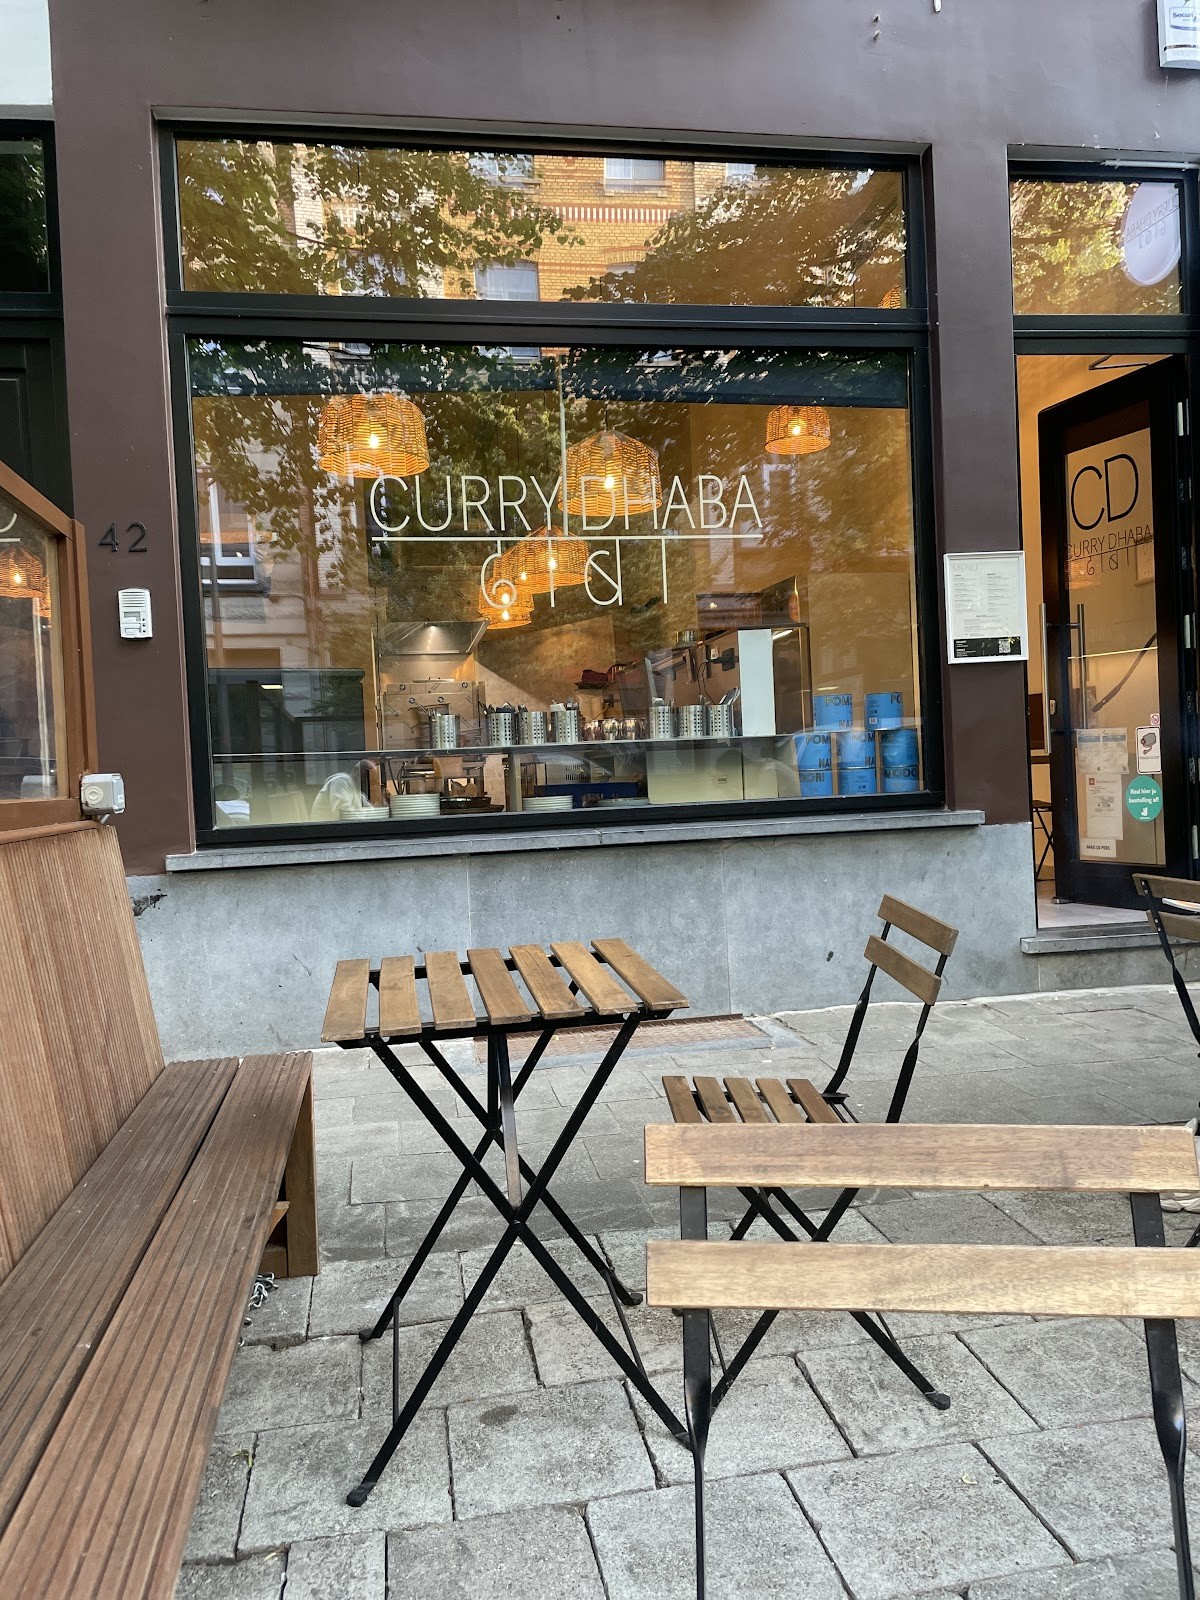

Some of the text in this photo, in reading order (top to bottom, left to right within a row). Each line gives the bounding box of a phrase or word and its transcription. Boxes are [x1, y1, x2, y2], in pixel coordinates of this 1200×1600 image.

[370, 474, 762, 531] CURRY DHABA
[1071, 453, 1139, 530] CD
[99, 521, 147, 552] 42
[1066, 524, 1152, 560] CURRY DHABA
[952, 563, 978, 573] MENU
